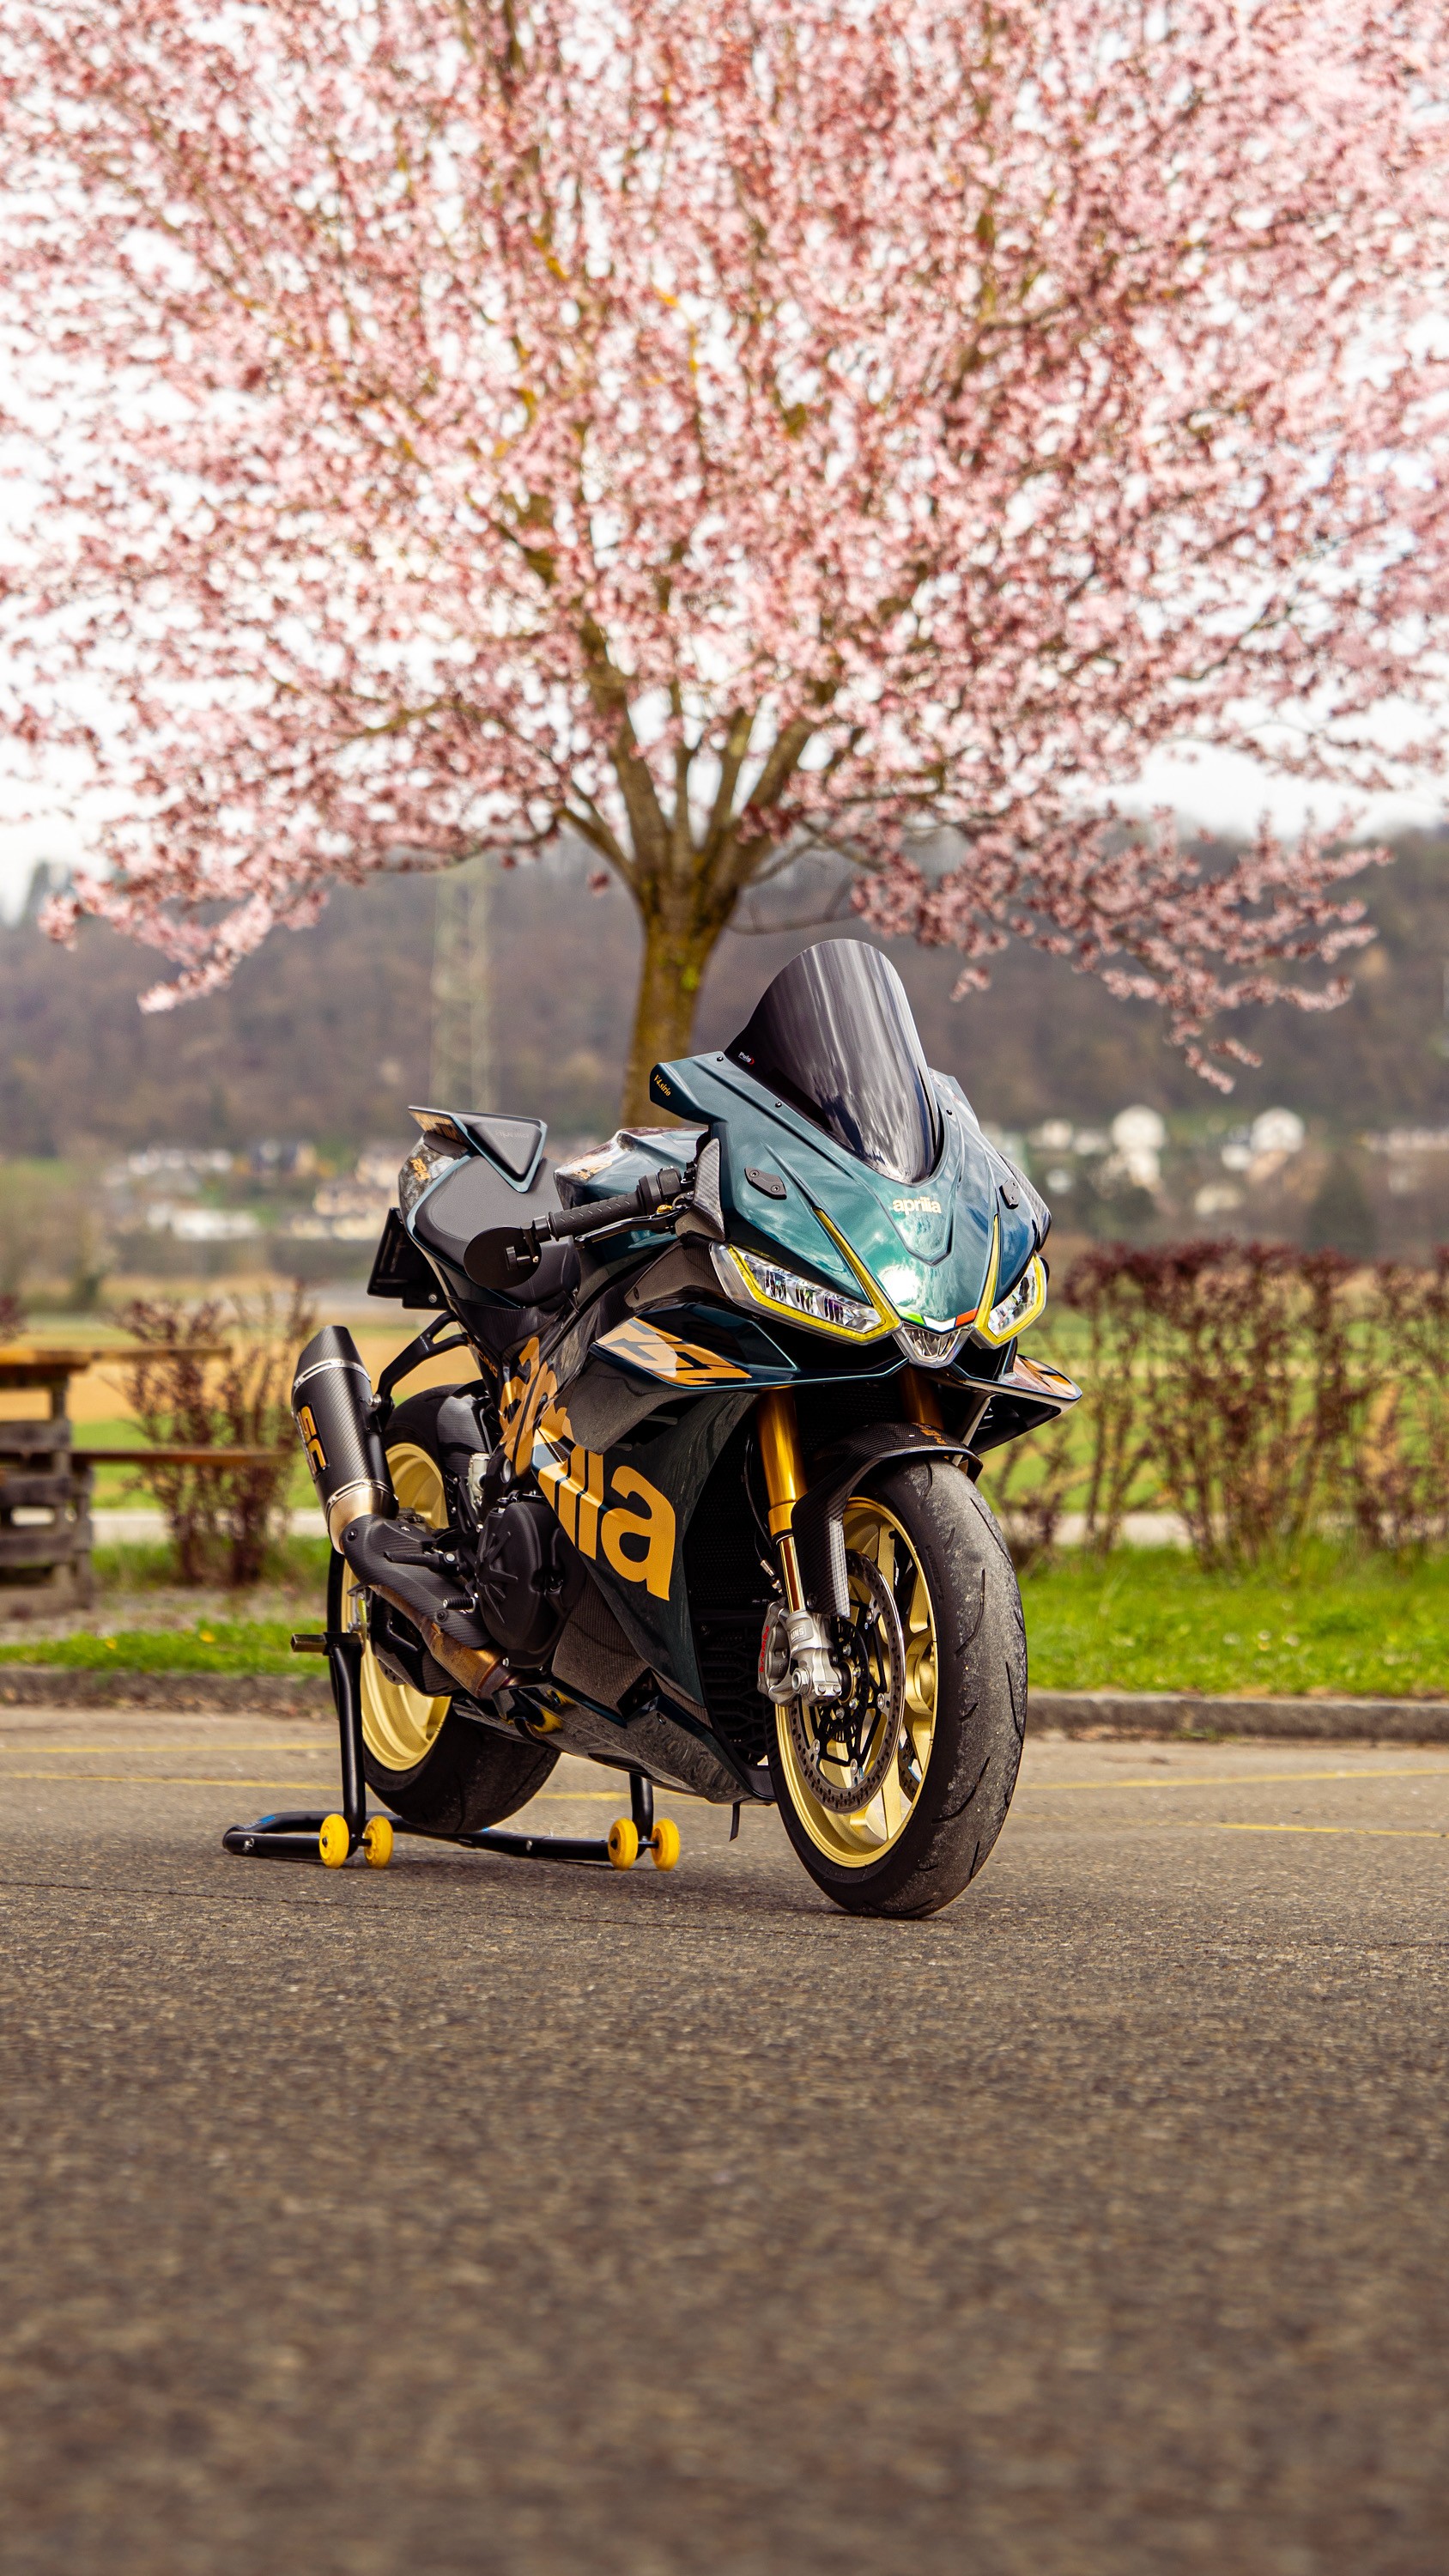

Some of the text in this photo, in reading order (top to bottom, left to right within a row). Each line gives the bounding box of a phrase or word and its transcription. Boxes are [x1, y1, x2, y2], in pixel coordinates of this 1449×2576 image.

[738, 1051, 752, 1063] Puig
[893, 1196, 942, 1215] aprilia
[759, 1625, 770, 1673] brembo
